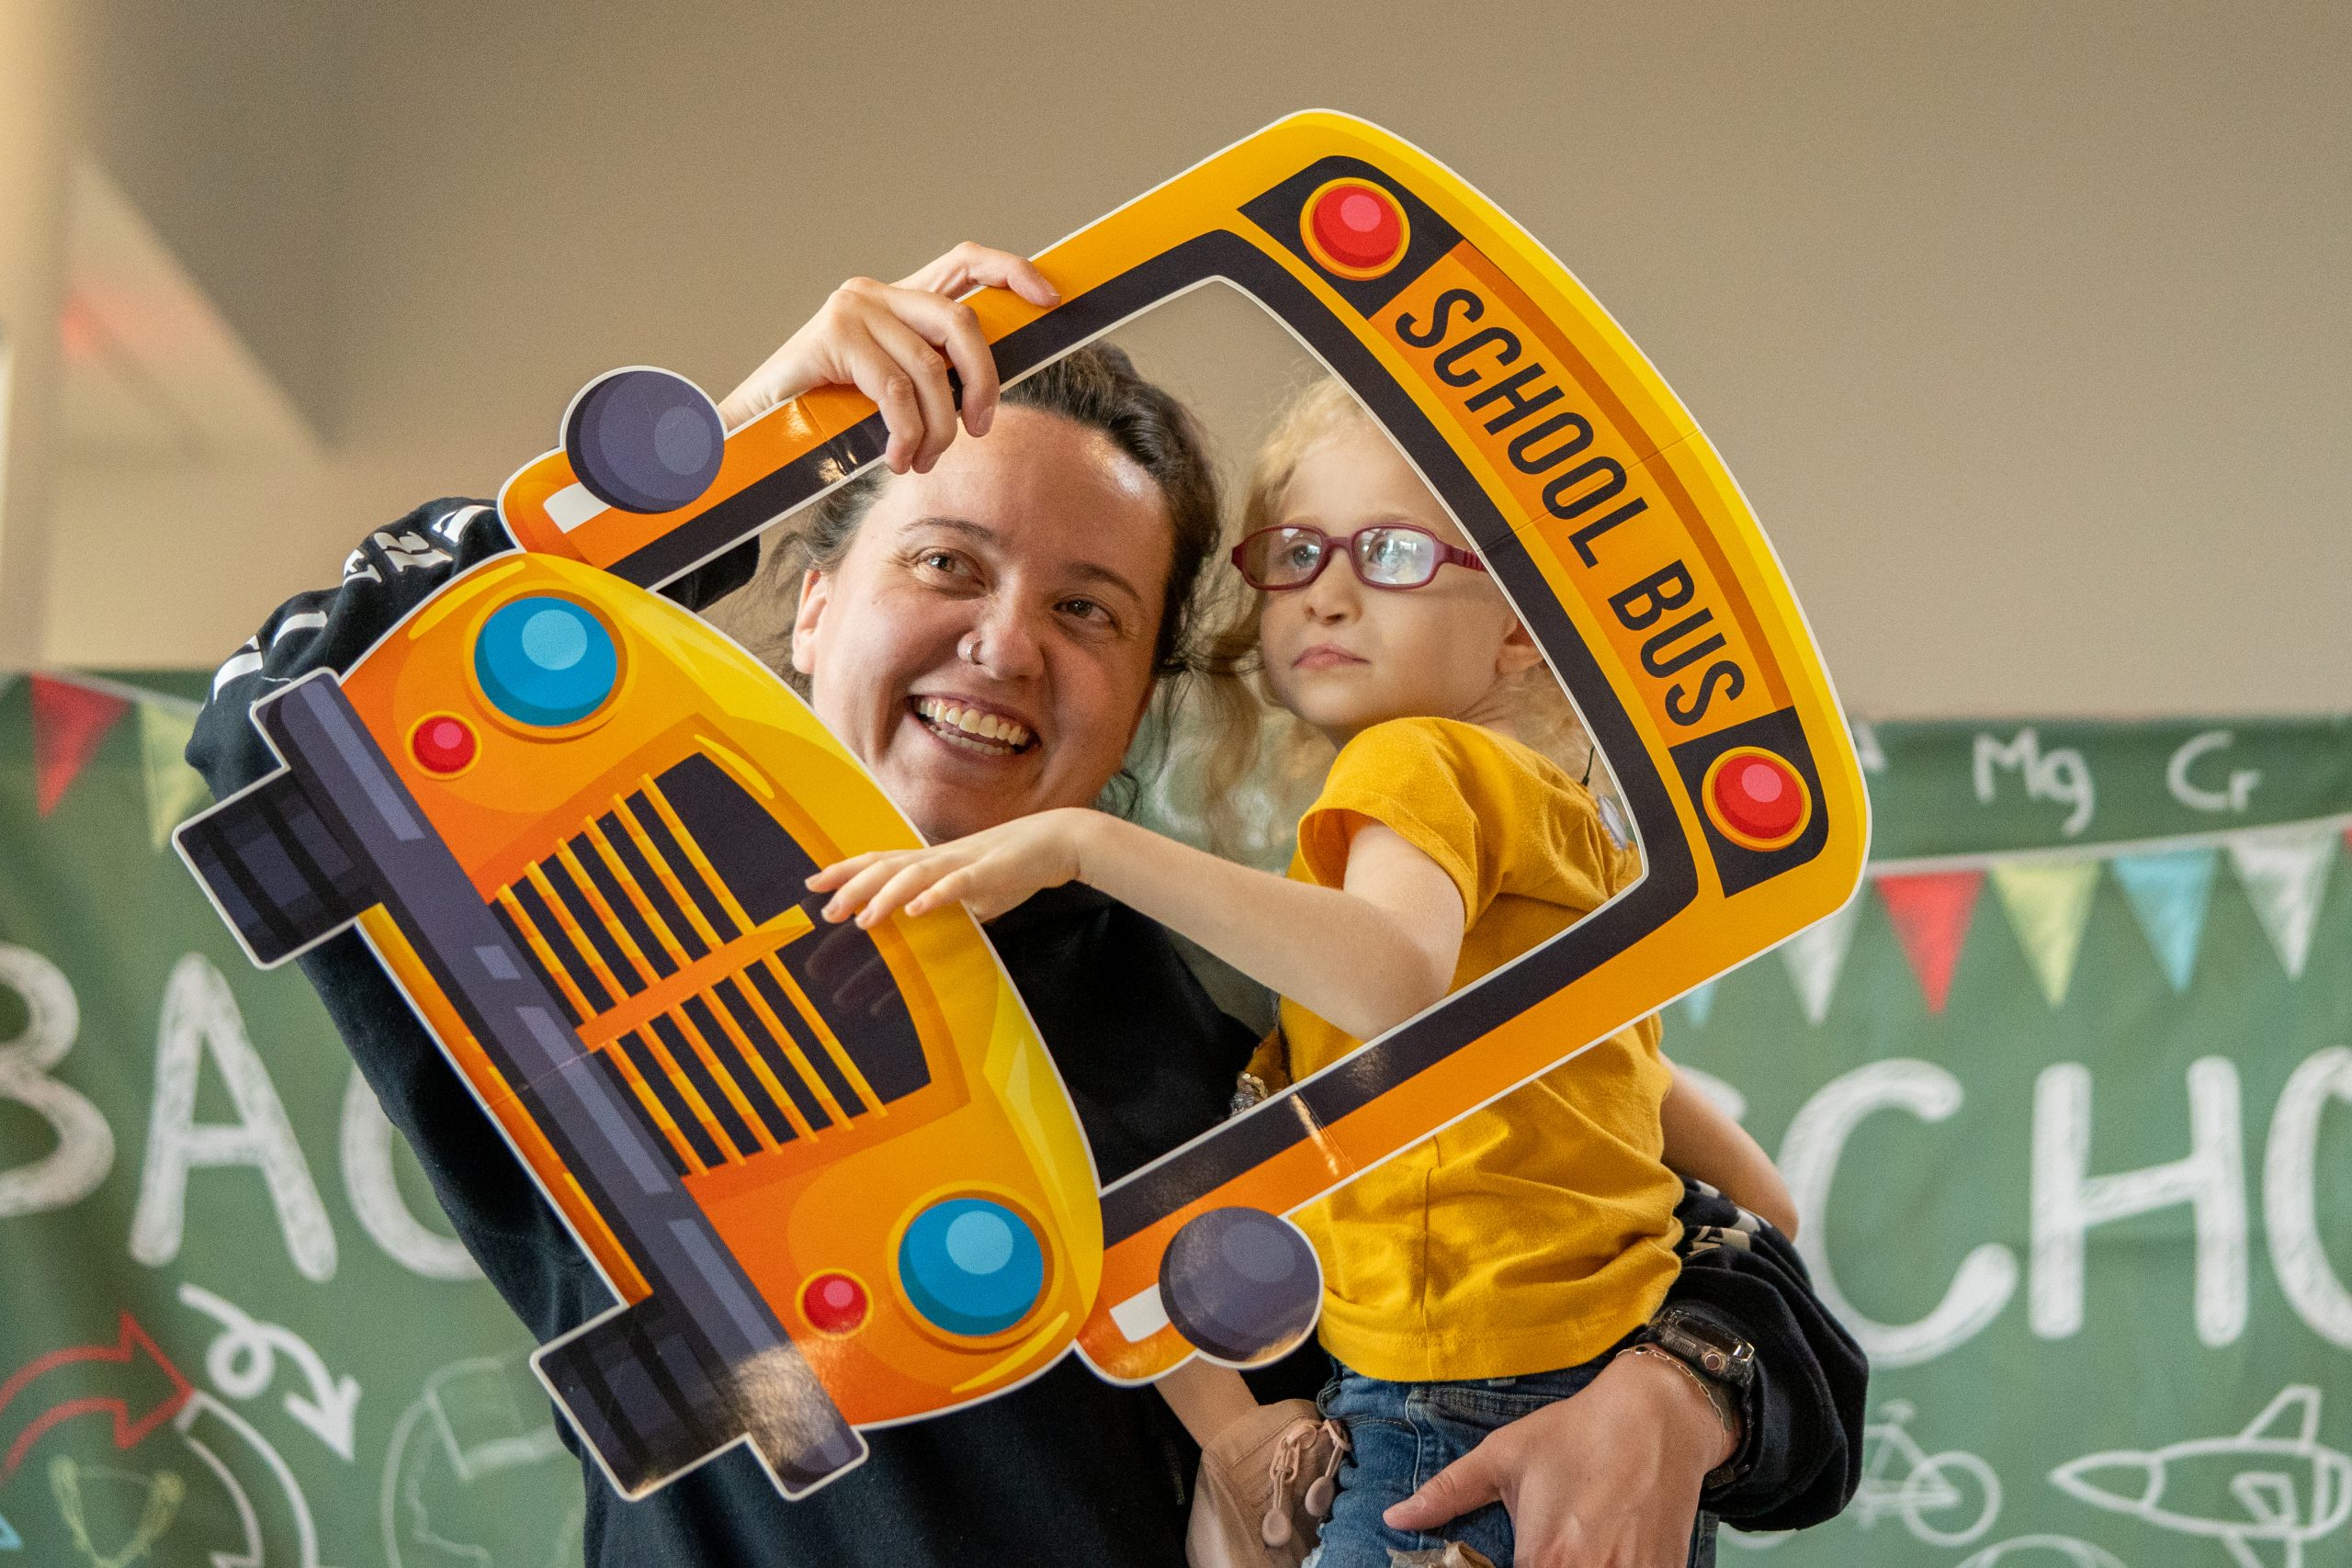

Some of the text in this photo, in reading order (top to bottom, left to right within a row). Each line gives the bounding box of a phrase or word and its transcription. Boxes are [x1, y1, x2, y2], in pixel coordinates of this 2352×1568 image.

[1396, 288, 1746, 727] SCHOOL BUS
[1973, 728, 2096, 837] Mg
[2165, 731, 2261, 812] Cr
[1678, 1047, 2352, 1368] CH
